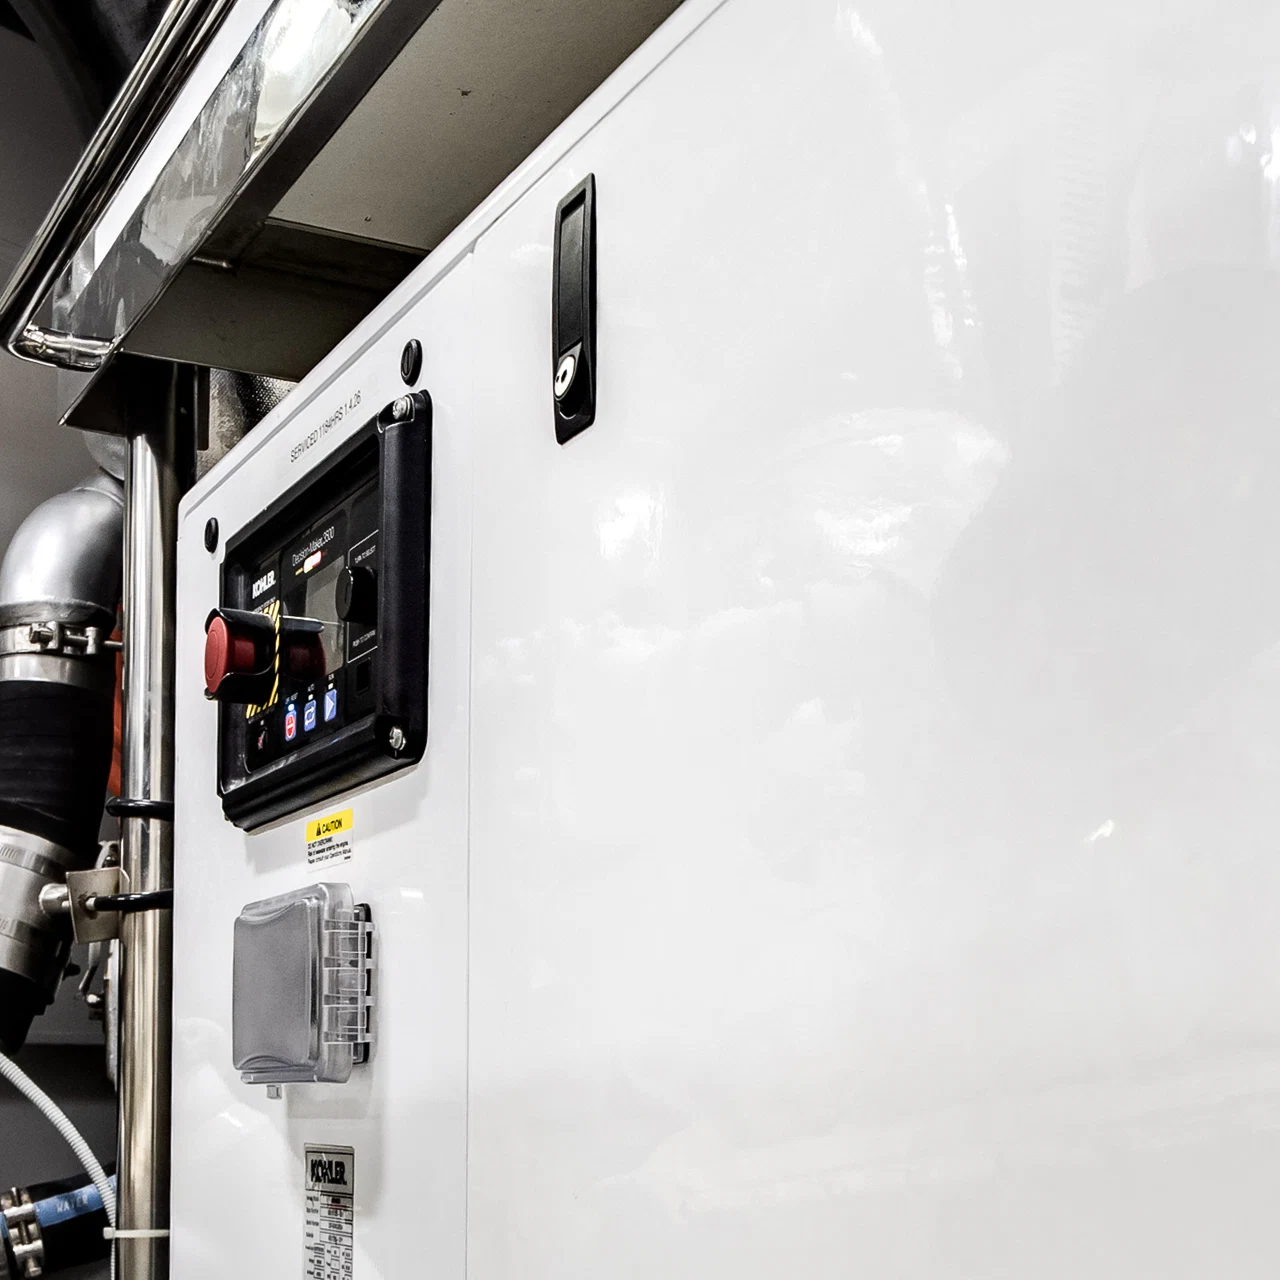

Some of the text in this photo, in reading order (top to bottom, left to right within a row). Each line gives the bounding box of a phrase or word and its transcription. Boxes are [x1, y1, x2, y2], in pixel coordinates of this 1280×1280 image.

[291, 430, 318, 463] SERVICED
[252, 570, 276, 599] KOHLER
[322, 818, 342, 834] CAUTION
[310, 1159, 347, 1185] KOHLER
